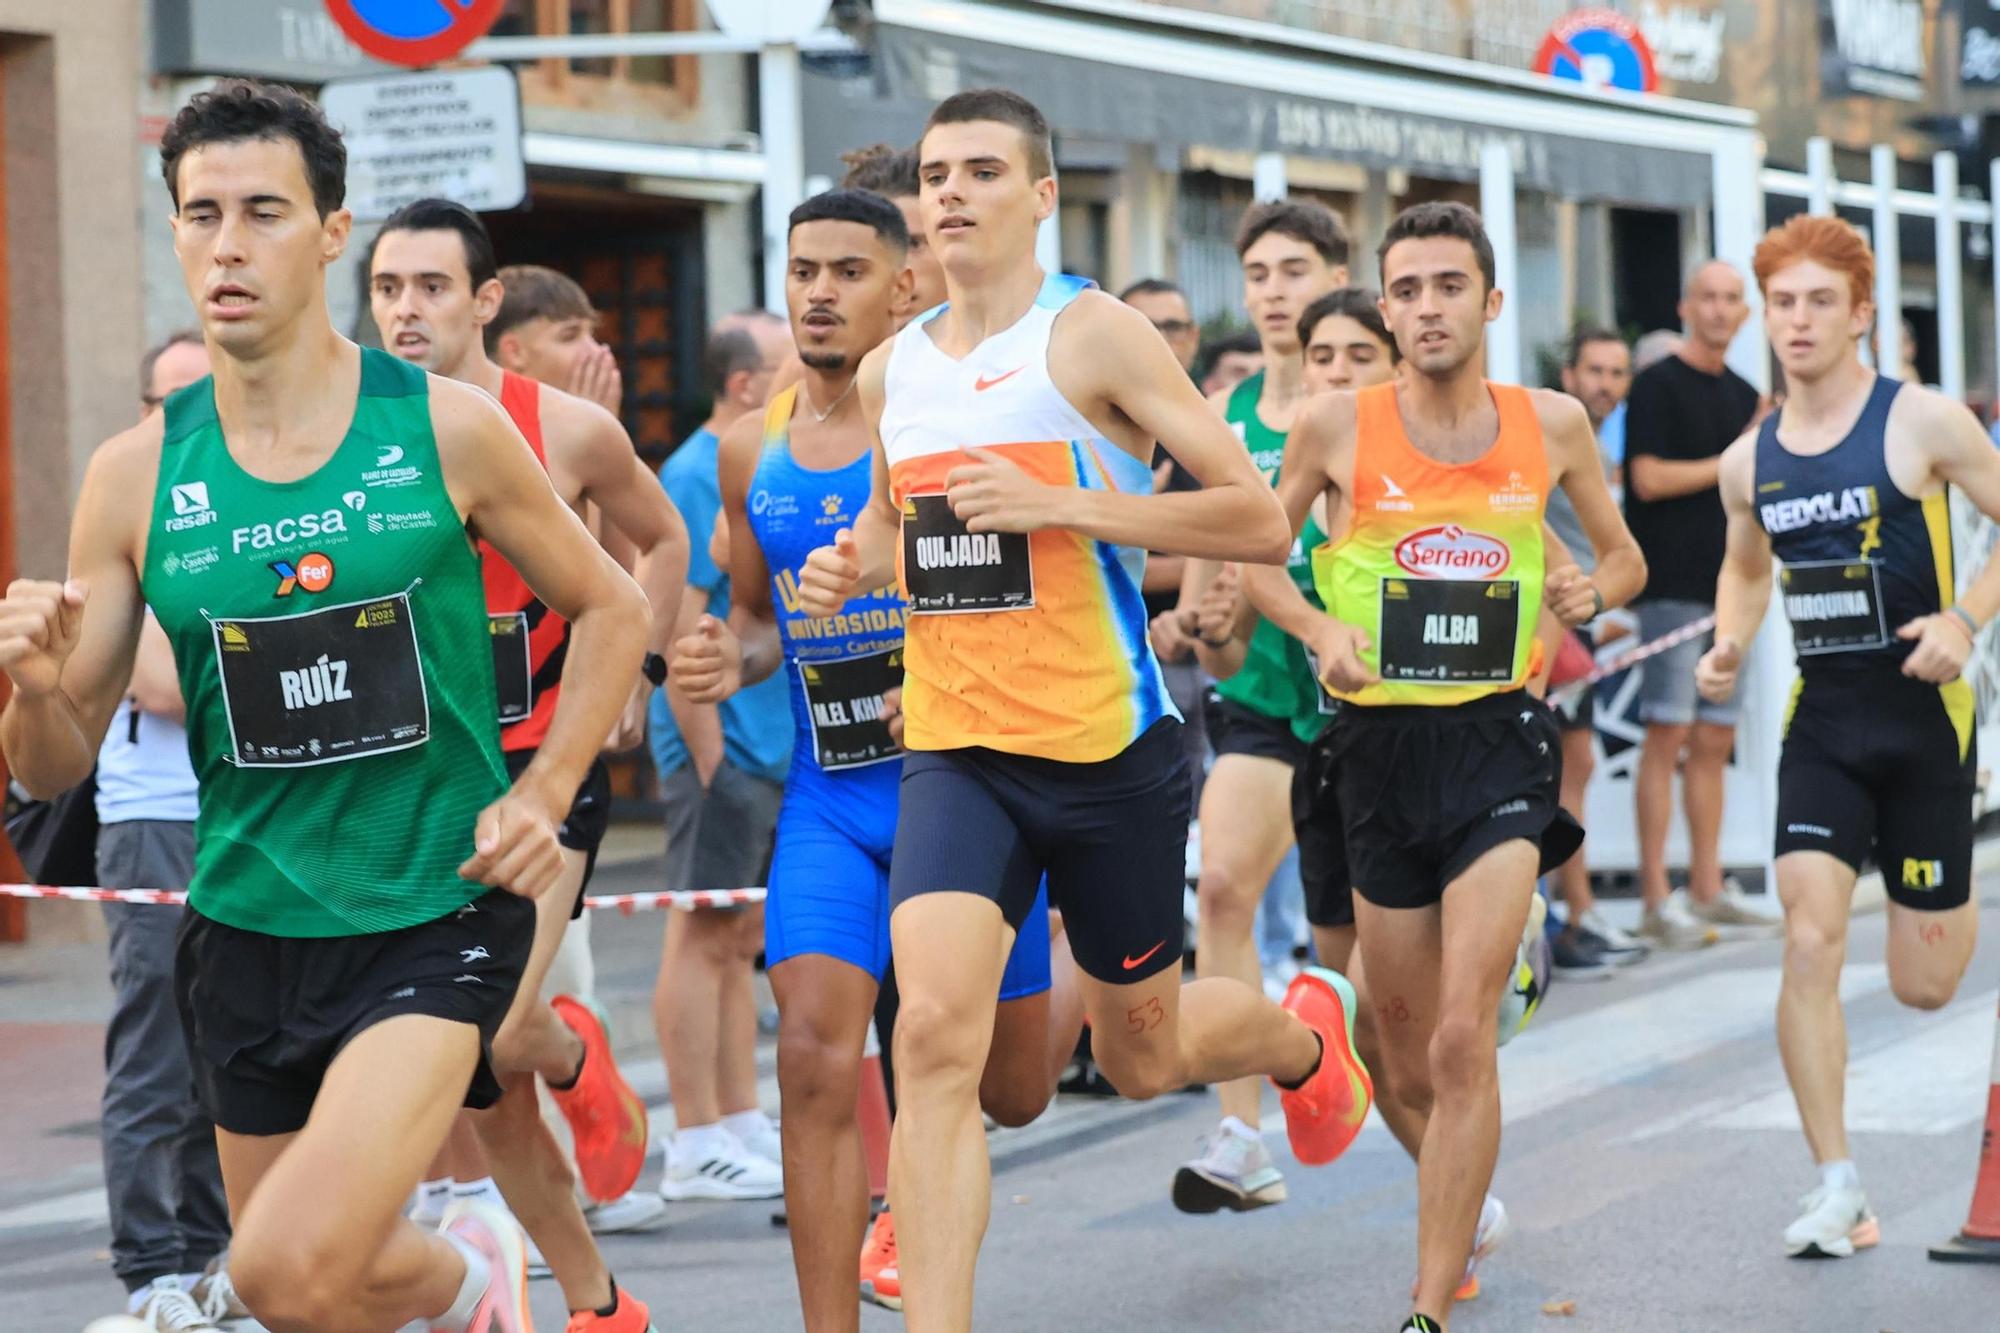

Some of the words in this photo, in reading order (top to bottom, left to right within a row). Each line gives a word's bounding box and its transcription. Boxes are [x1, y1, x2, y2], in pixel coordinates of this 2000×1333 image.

[232, 509, 348, 554] Facsa
[916, 533, 1002, 570] QUIJADA
[1407, 542, 1501, 568] Serrano
[370, 609, 396, 622] 2025
[1422, 614, 1480, 645] ALBA
[279, 653, 353, 710] RUÍZ
